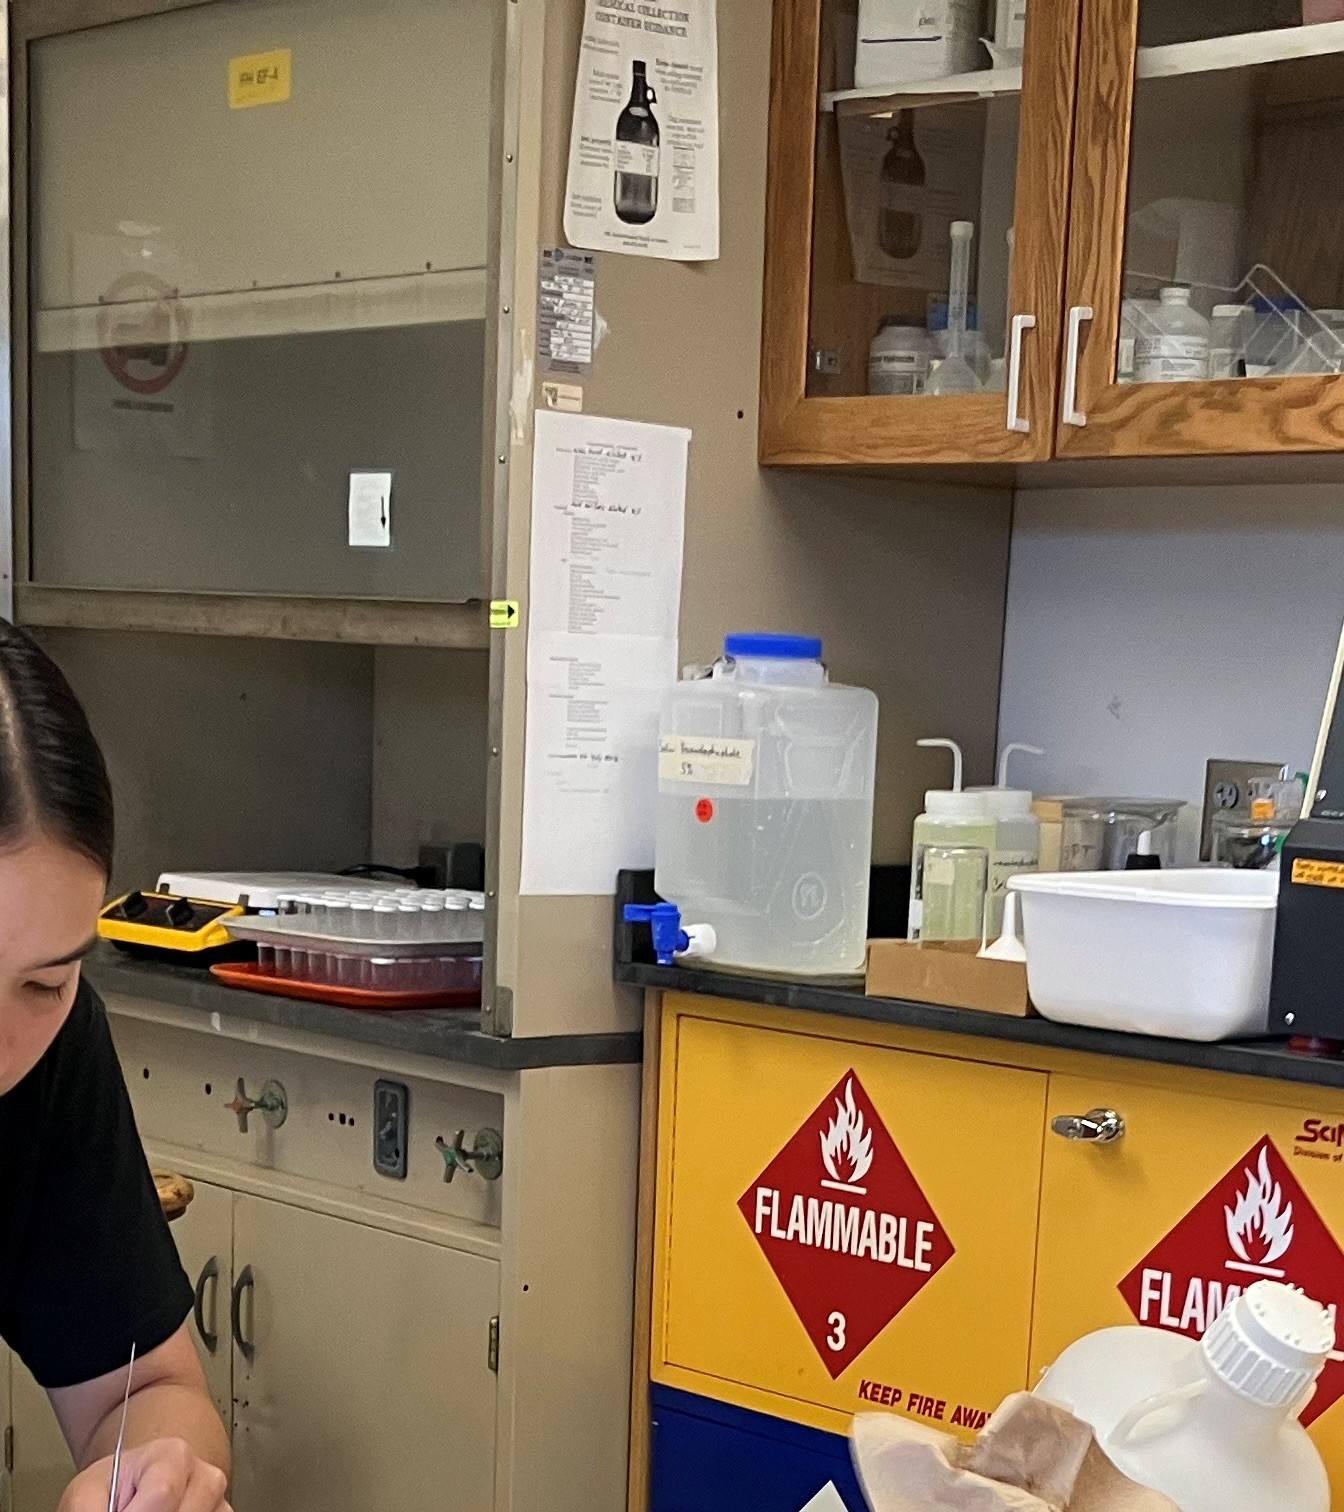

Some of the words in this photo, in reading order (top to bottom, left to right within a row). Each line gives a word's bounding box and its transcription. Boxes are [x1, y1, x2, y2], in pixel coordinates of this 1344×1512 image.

[754, 1186, 935, 1273] FLAMMABLE
[826, 1310, 847, 1352] 3
[858, 1379, 903, 1407] KEEP
[906, 1392, 947, 1420] FIRE
[950, 1404, 993, 1430] AWA
